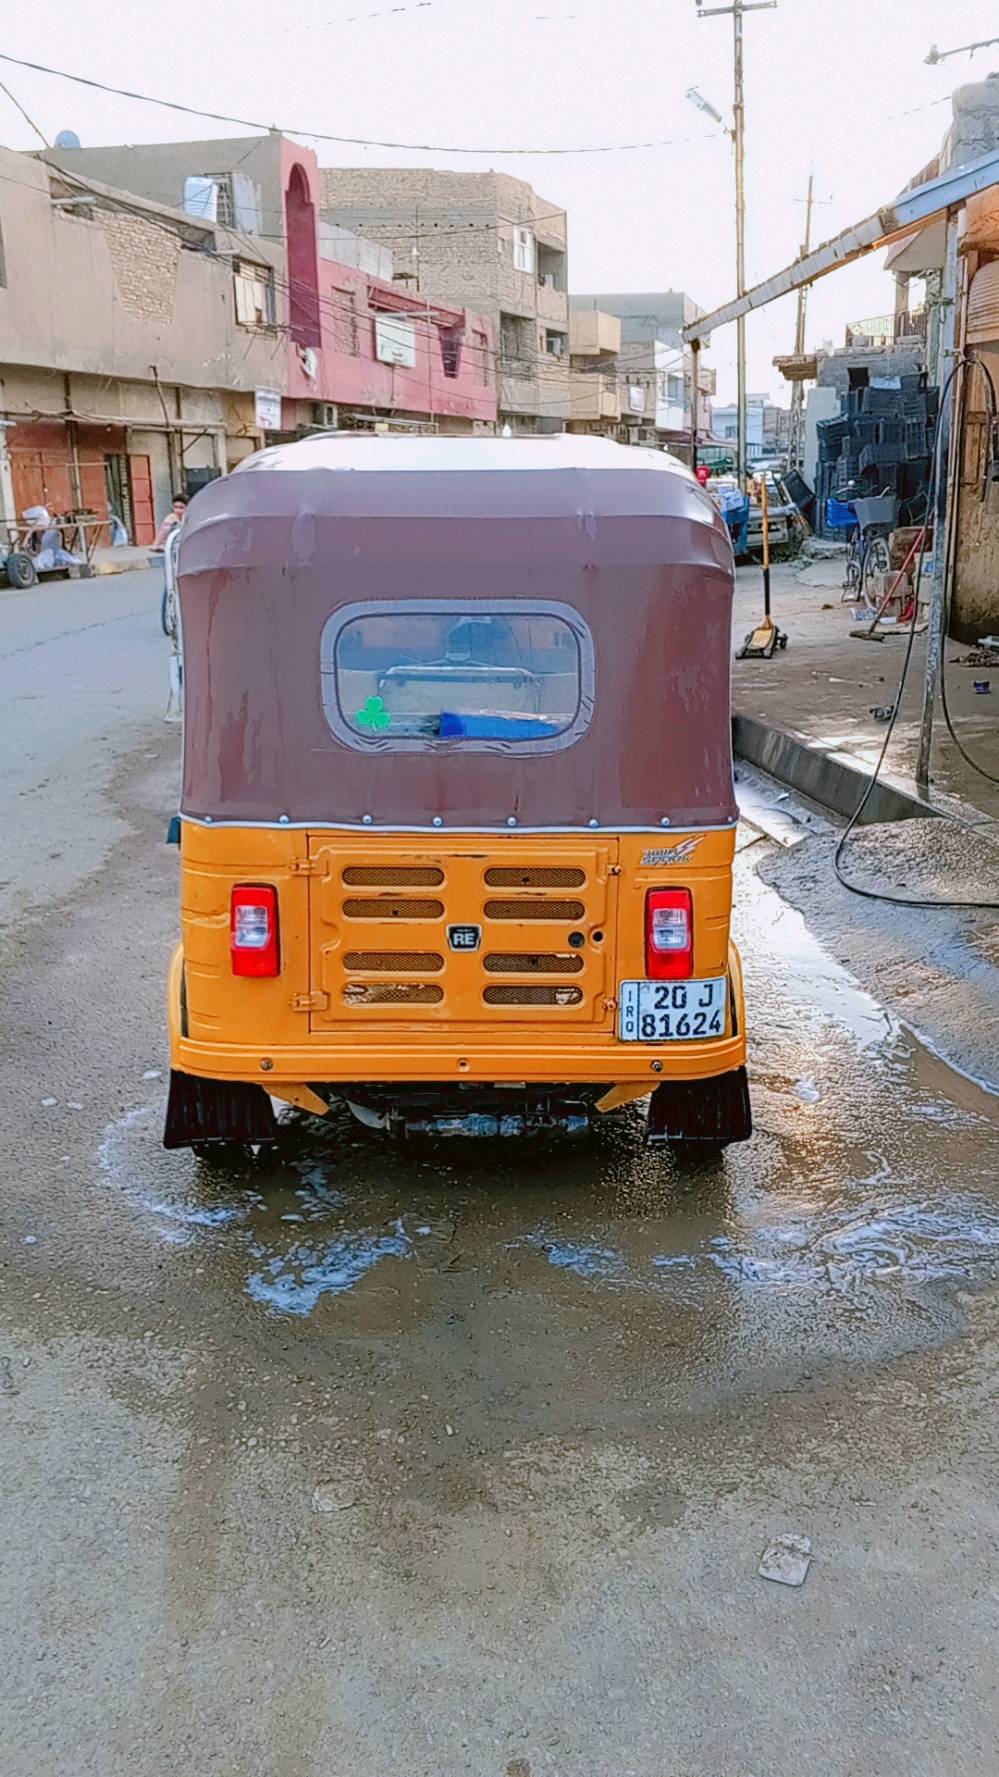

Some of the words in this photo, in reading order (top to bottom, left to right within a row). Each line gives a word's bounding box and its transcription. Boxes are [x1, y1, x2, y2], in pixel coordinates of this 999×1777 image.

[453, 933, 475, 945] RE
[654, 985, 687, 1009] 20
[699, 984, 713, 1007] J
[642, 1010, 721, 1037] 81624
